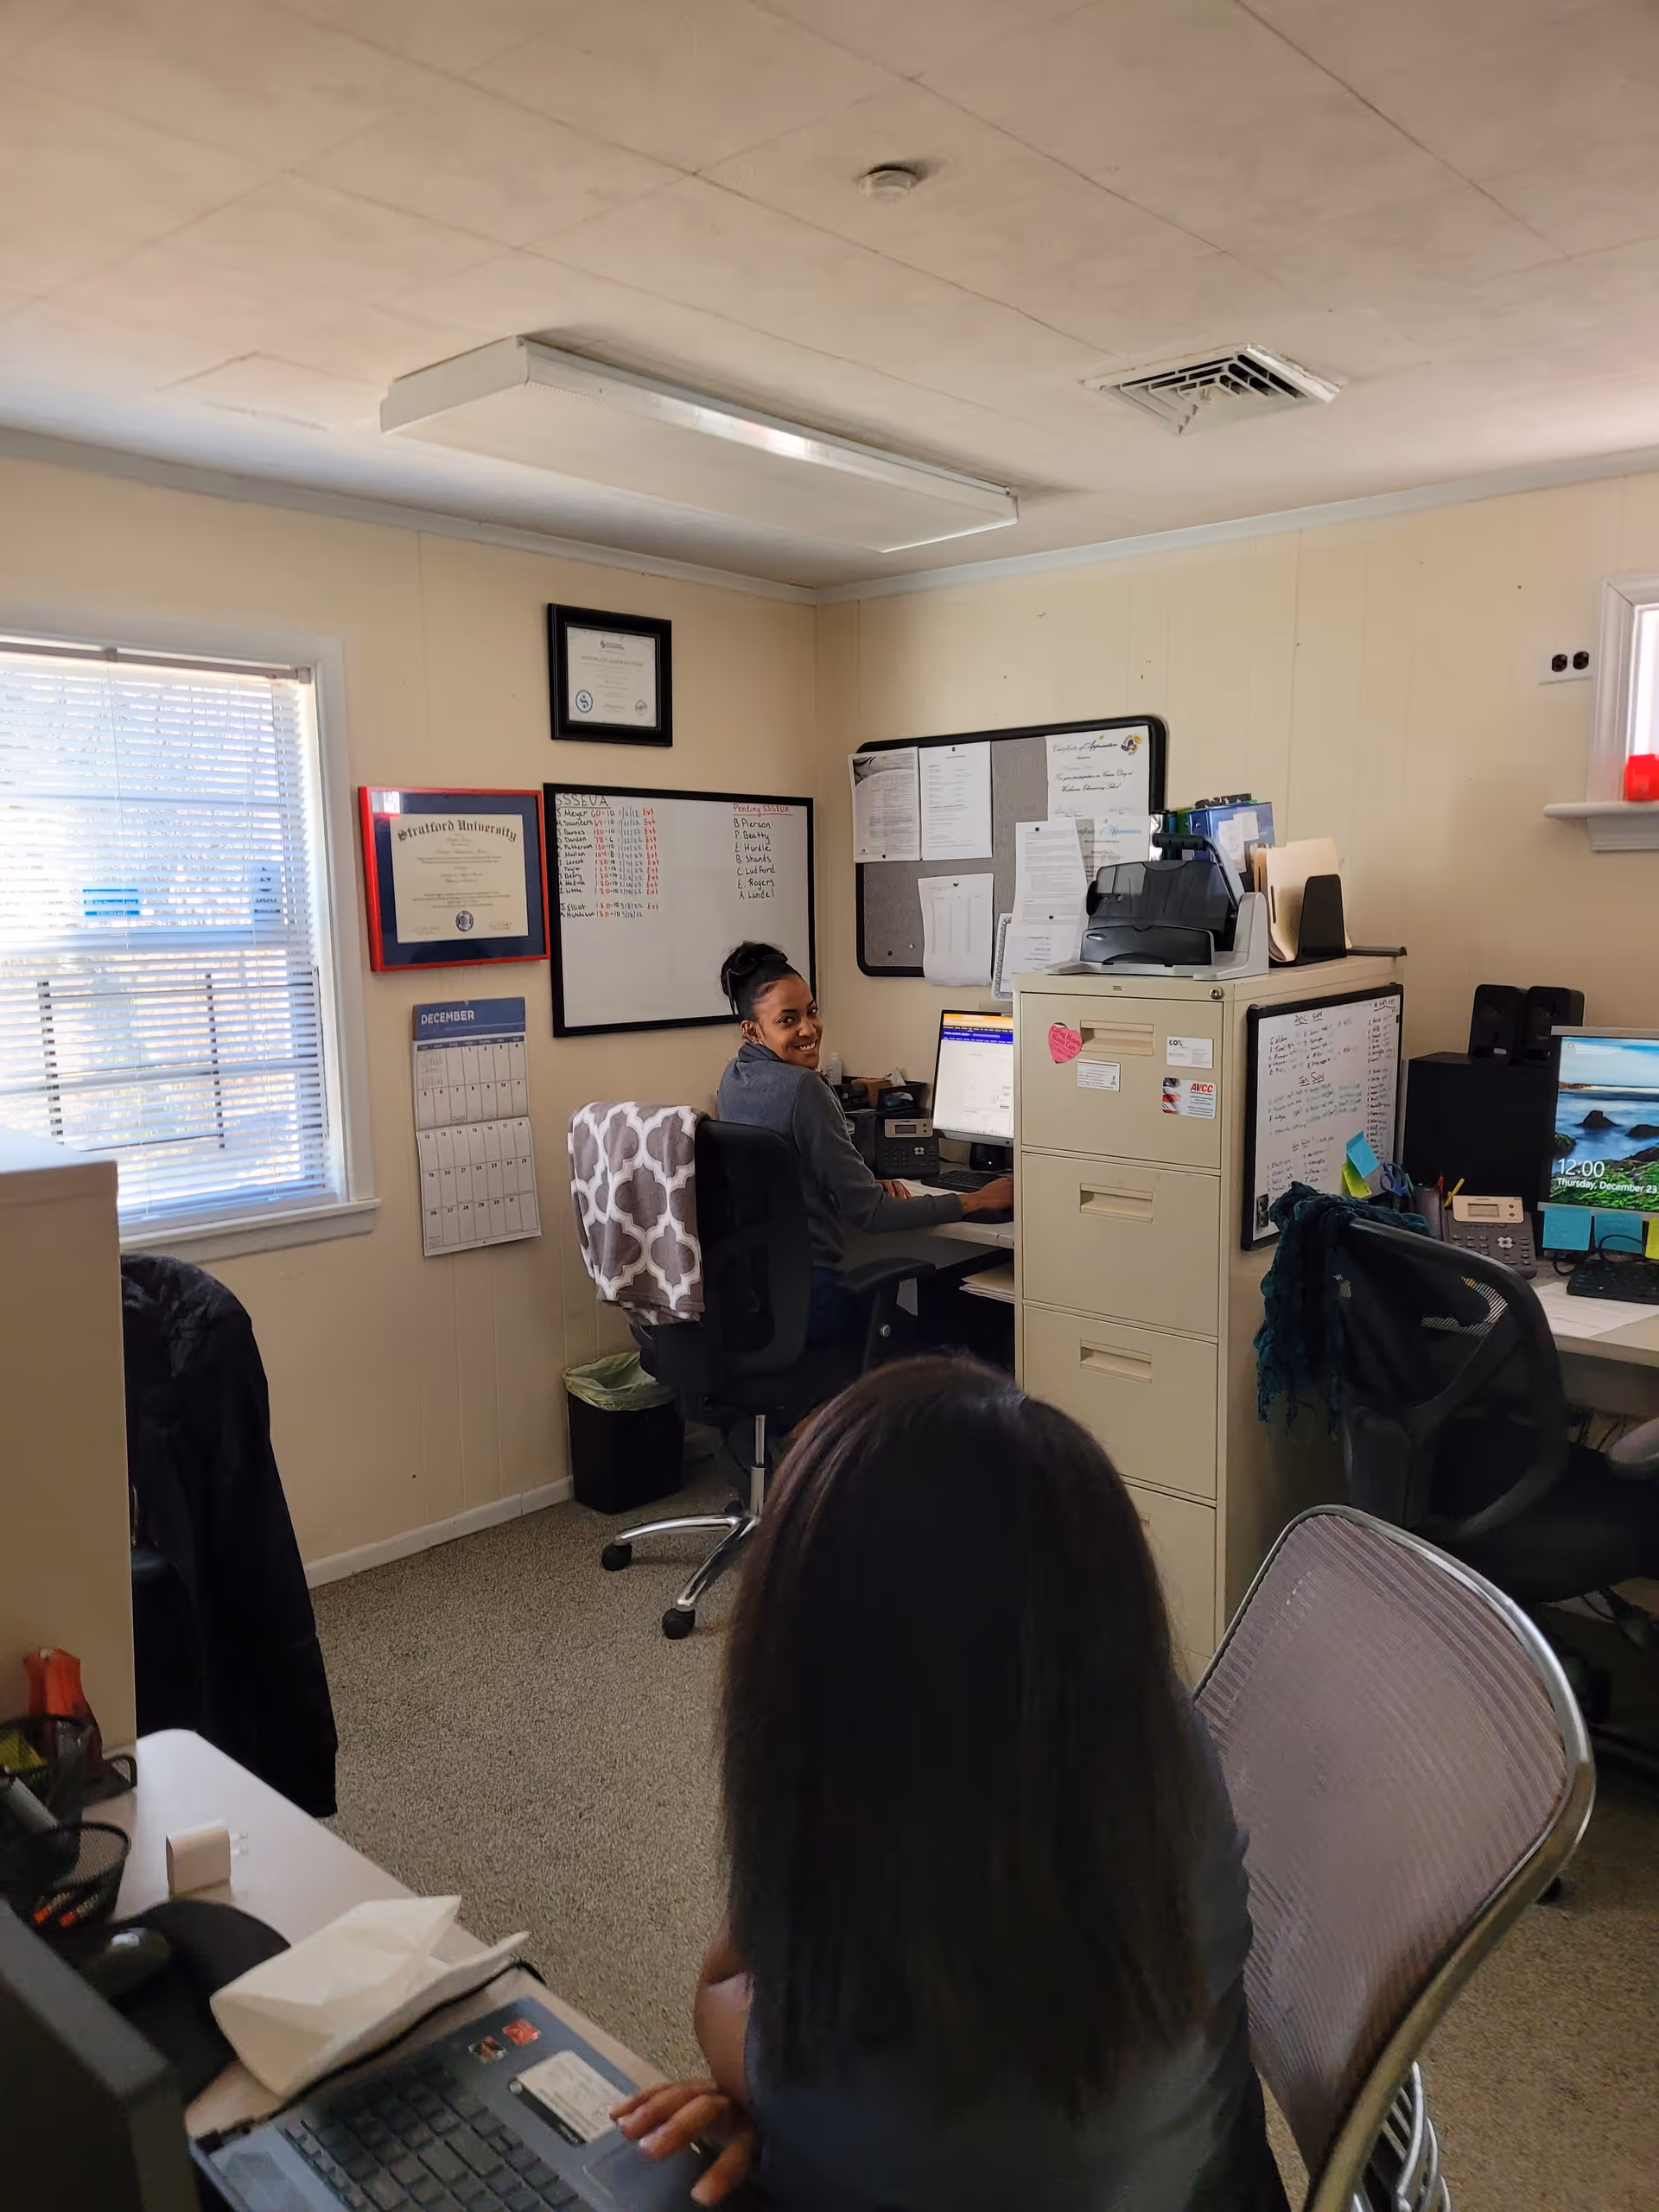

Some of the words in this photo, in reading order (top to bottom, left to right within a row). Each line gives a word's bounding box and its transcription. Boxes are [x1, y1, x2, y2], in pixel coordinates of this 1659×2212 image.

[565, 809, 588, 820] Meyer
[734, 804, 761, 817] Pending
[742, 818, 771, 829] Pierson
[397, 820, 454, 842] Stratford
[457, 820, 517, 842] University
[743, 830, 770, 845] Beatty
[744, 843, 771, 852] Hurdle
[746, 853, 771, 863] Shands
[748, 877, 775, 890] Rogers
[567, 902, 585, 911] Elliot
[421, 1010, 475, 1025] DECEMBER
[1558, 1158, 1605, 1178] 12:00
[1557, 1177, 1597, 1190] Thursday,
[1600, 1181, 1645, 1193] December
[1646, 1185, 1657, 1194] 23
